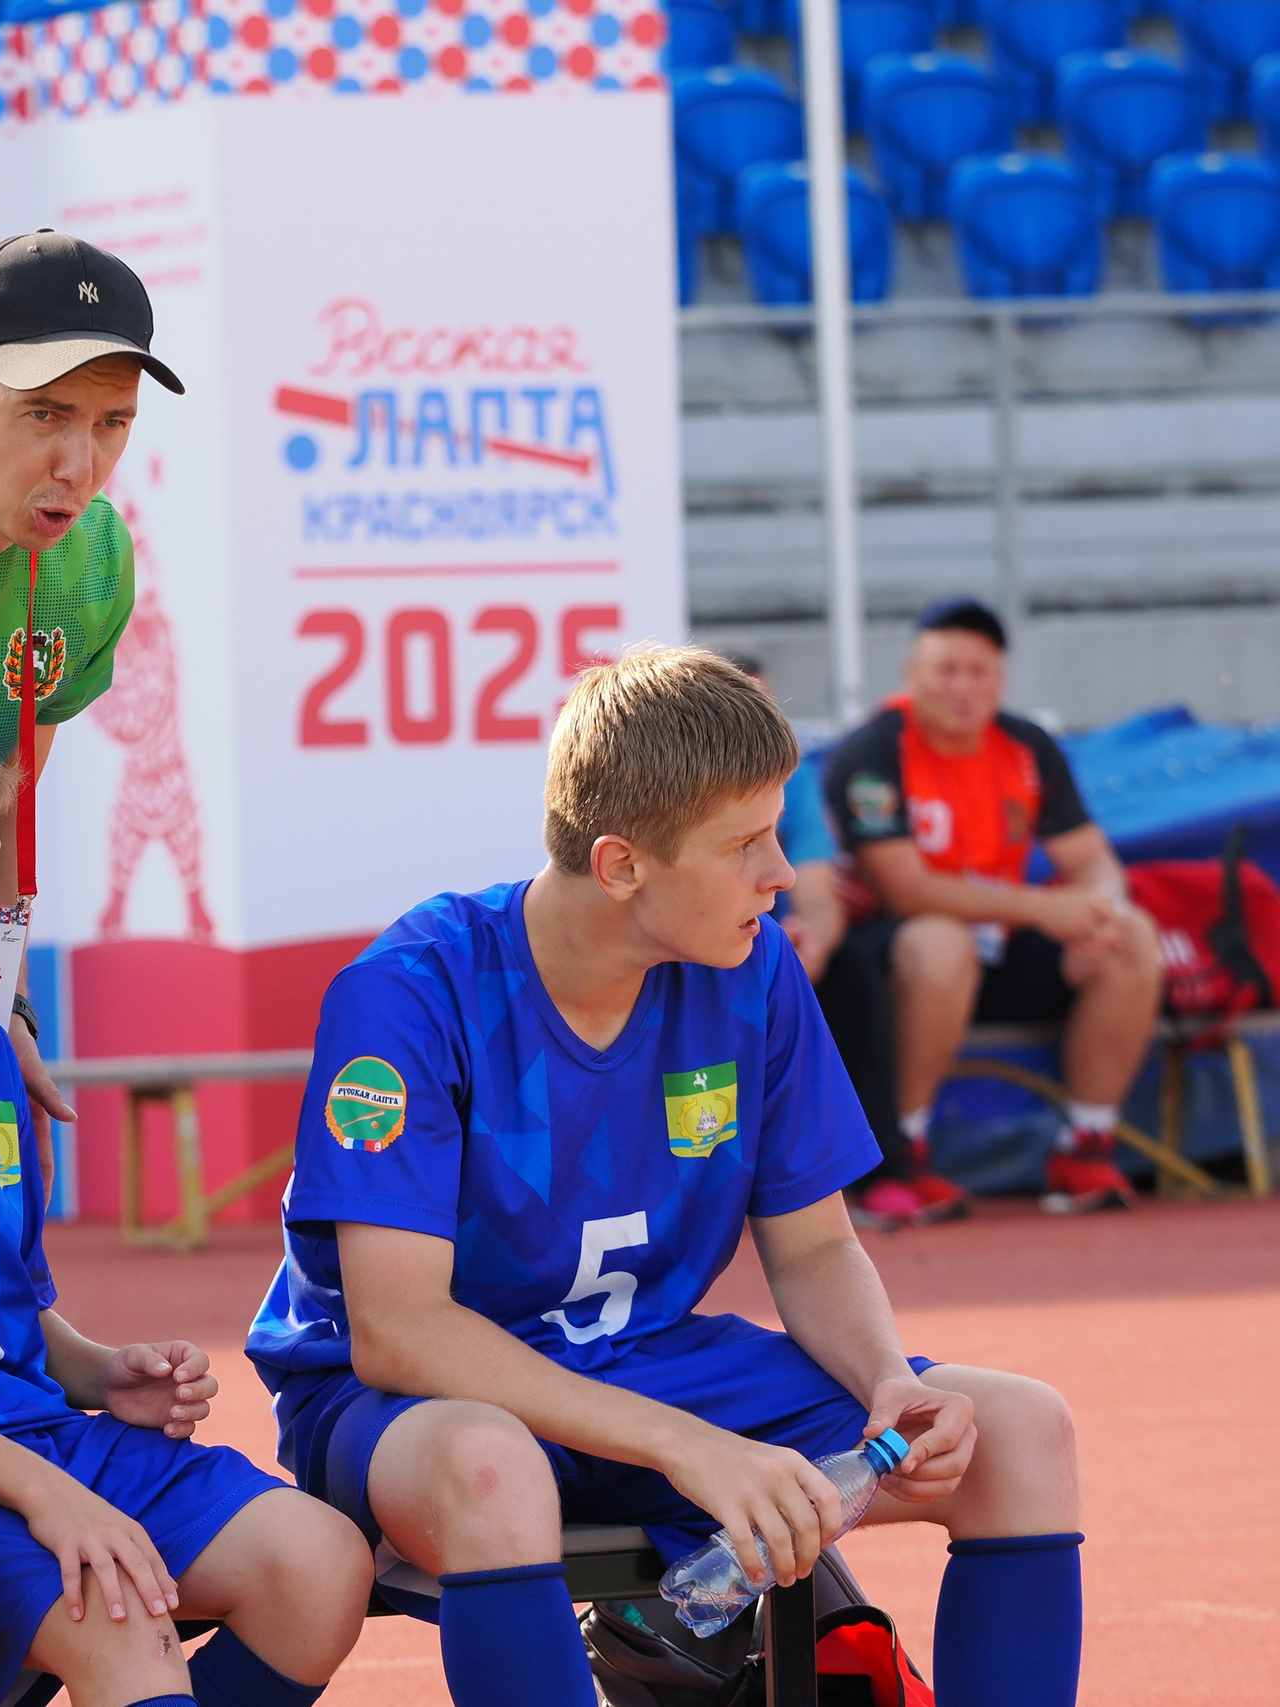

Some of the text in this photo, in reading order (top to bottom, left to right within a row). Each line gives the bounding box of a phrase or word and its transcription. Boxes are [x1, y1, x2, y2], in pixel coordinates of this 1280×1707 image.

[78, 281, 100, 304] NY
[308, 297, 588, 379] Русская
[346, 384, 616, 498] ЛАПТА
[302, 490, 618, 541] КРАСНОЯРСК
[337, 1087, 399, 1105] РУССКАЯ ЛАПТА
[539, 1210, 650, 1346] 5
